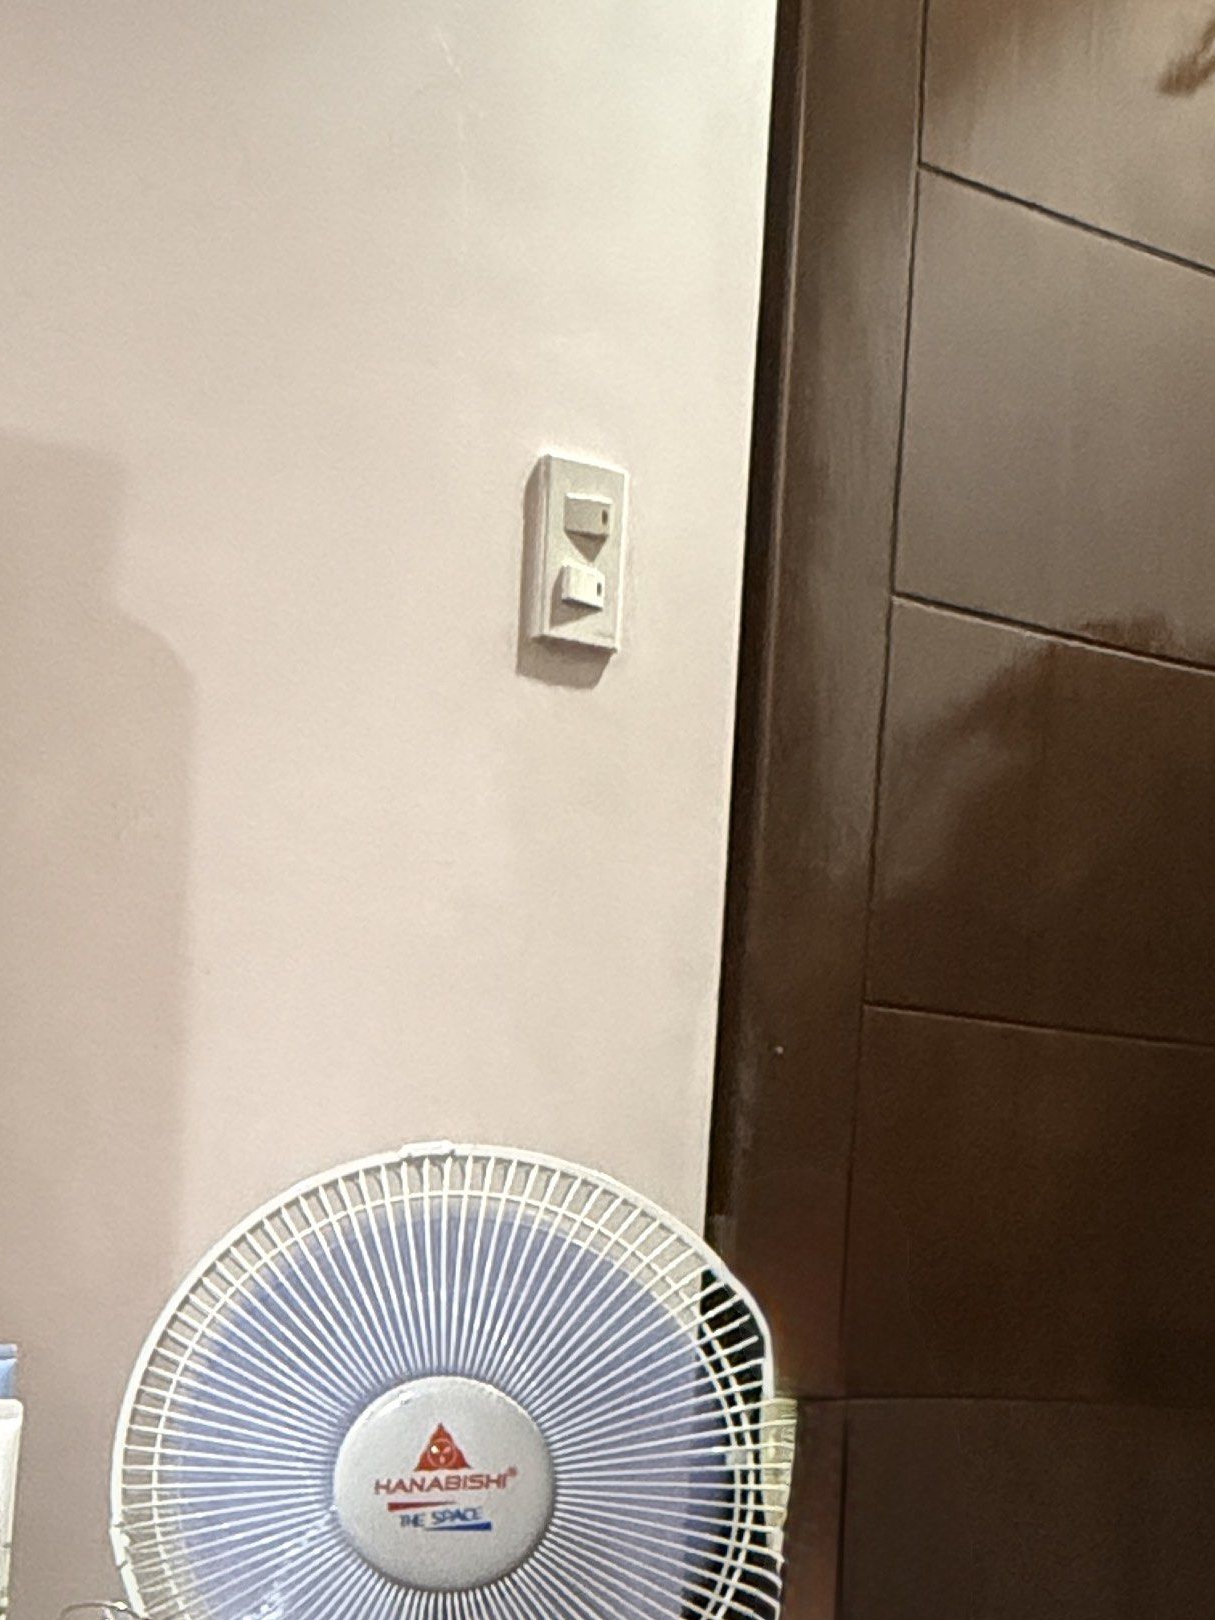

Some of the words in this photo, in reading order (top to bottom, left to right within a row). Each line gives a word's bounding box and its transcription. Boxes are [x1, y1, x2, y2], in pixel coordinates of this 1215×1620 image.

[373, 1471, 508, 1496] HANABISHI
[399, 1513, 425, 1528] THE
[430, 1507, 483, 1525] SPACE
